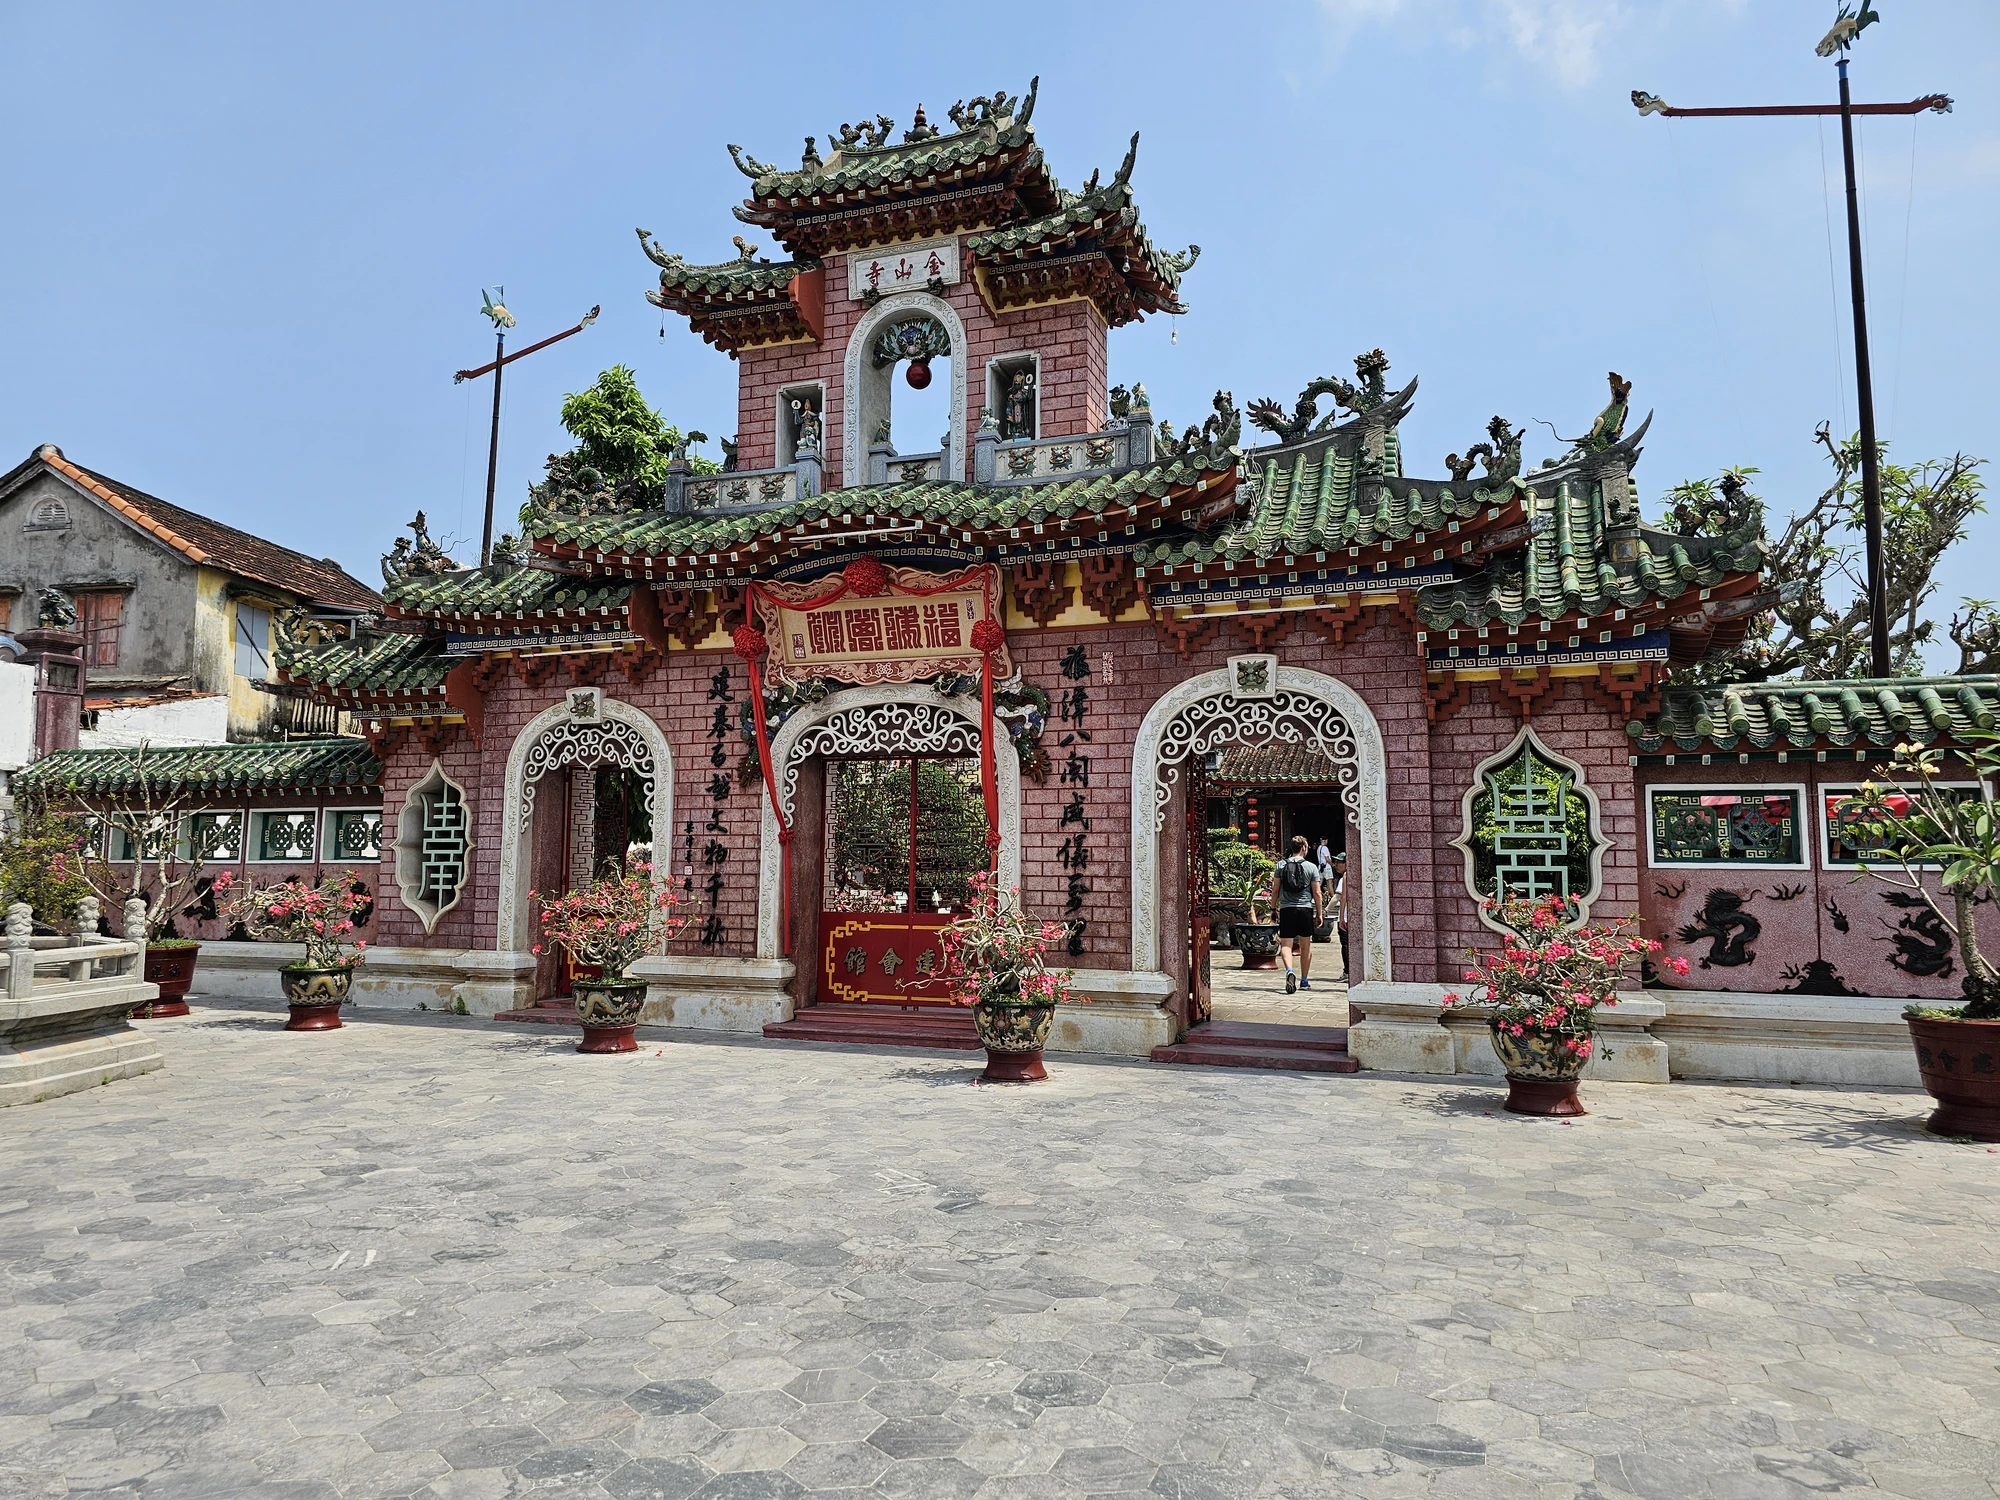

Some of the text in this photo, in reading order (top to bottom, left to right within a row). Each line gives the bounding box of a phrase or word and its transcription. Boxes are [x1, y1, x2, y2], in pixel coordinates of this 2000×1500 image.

[865, 250, 946, 289] 金山寺
[843, 946, 936, 977] 建會館
[1920, 1046, 1997, 1074] 建會館
